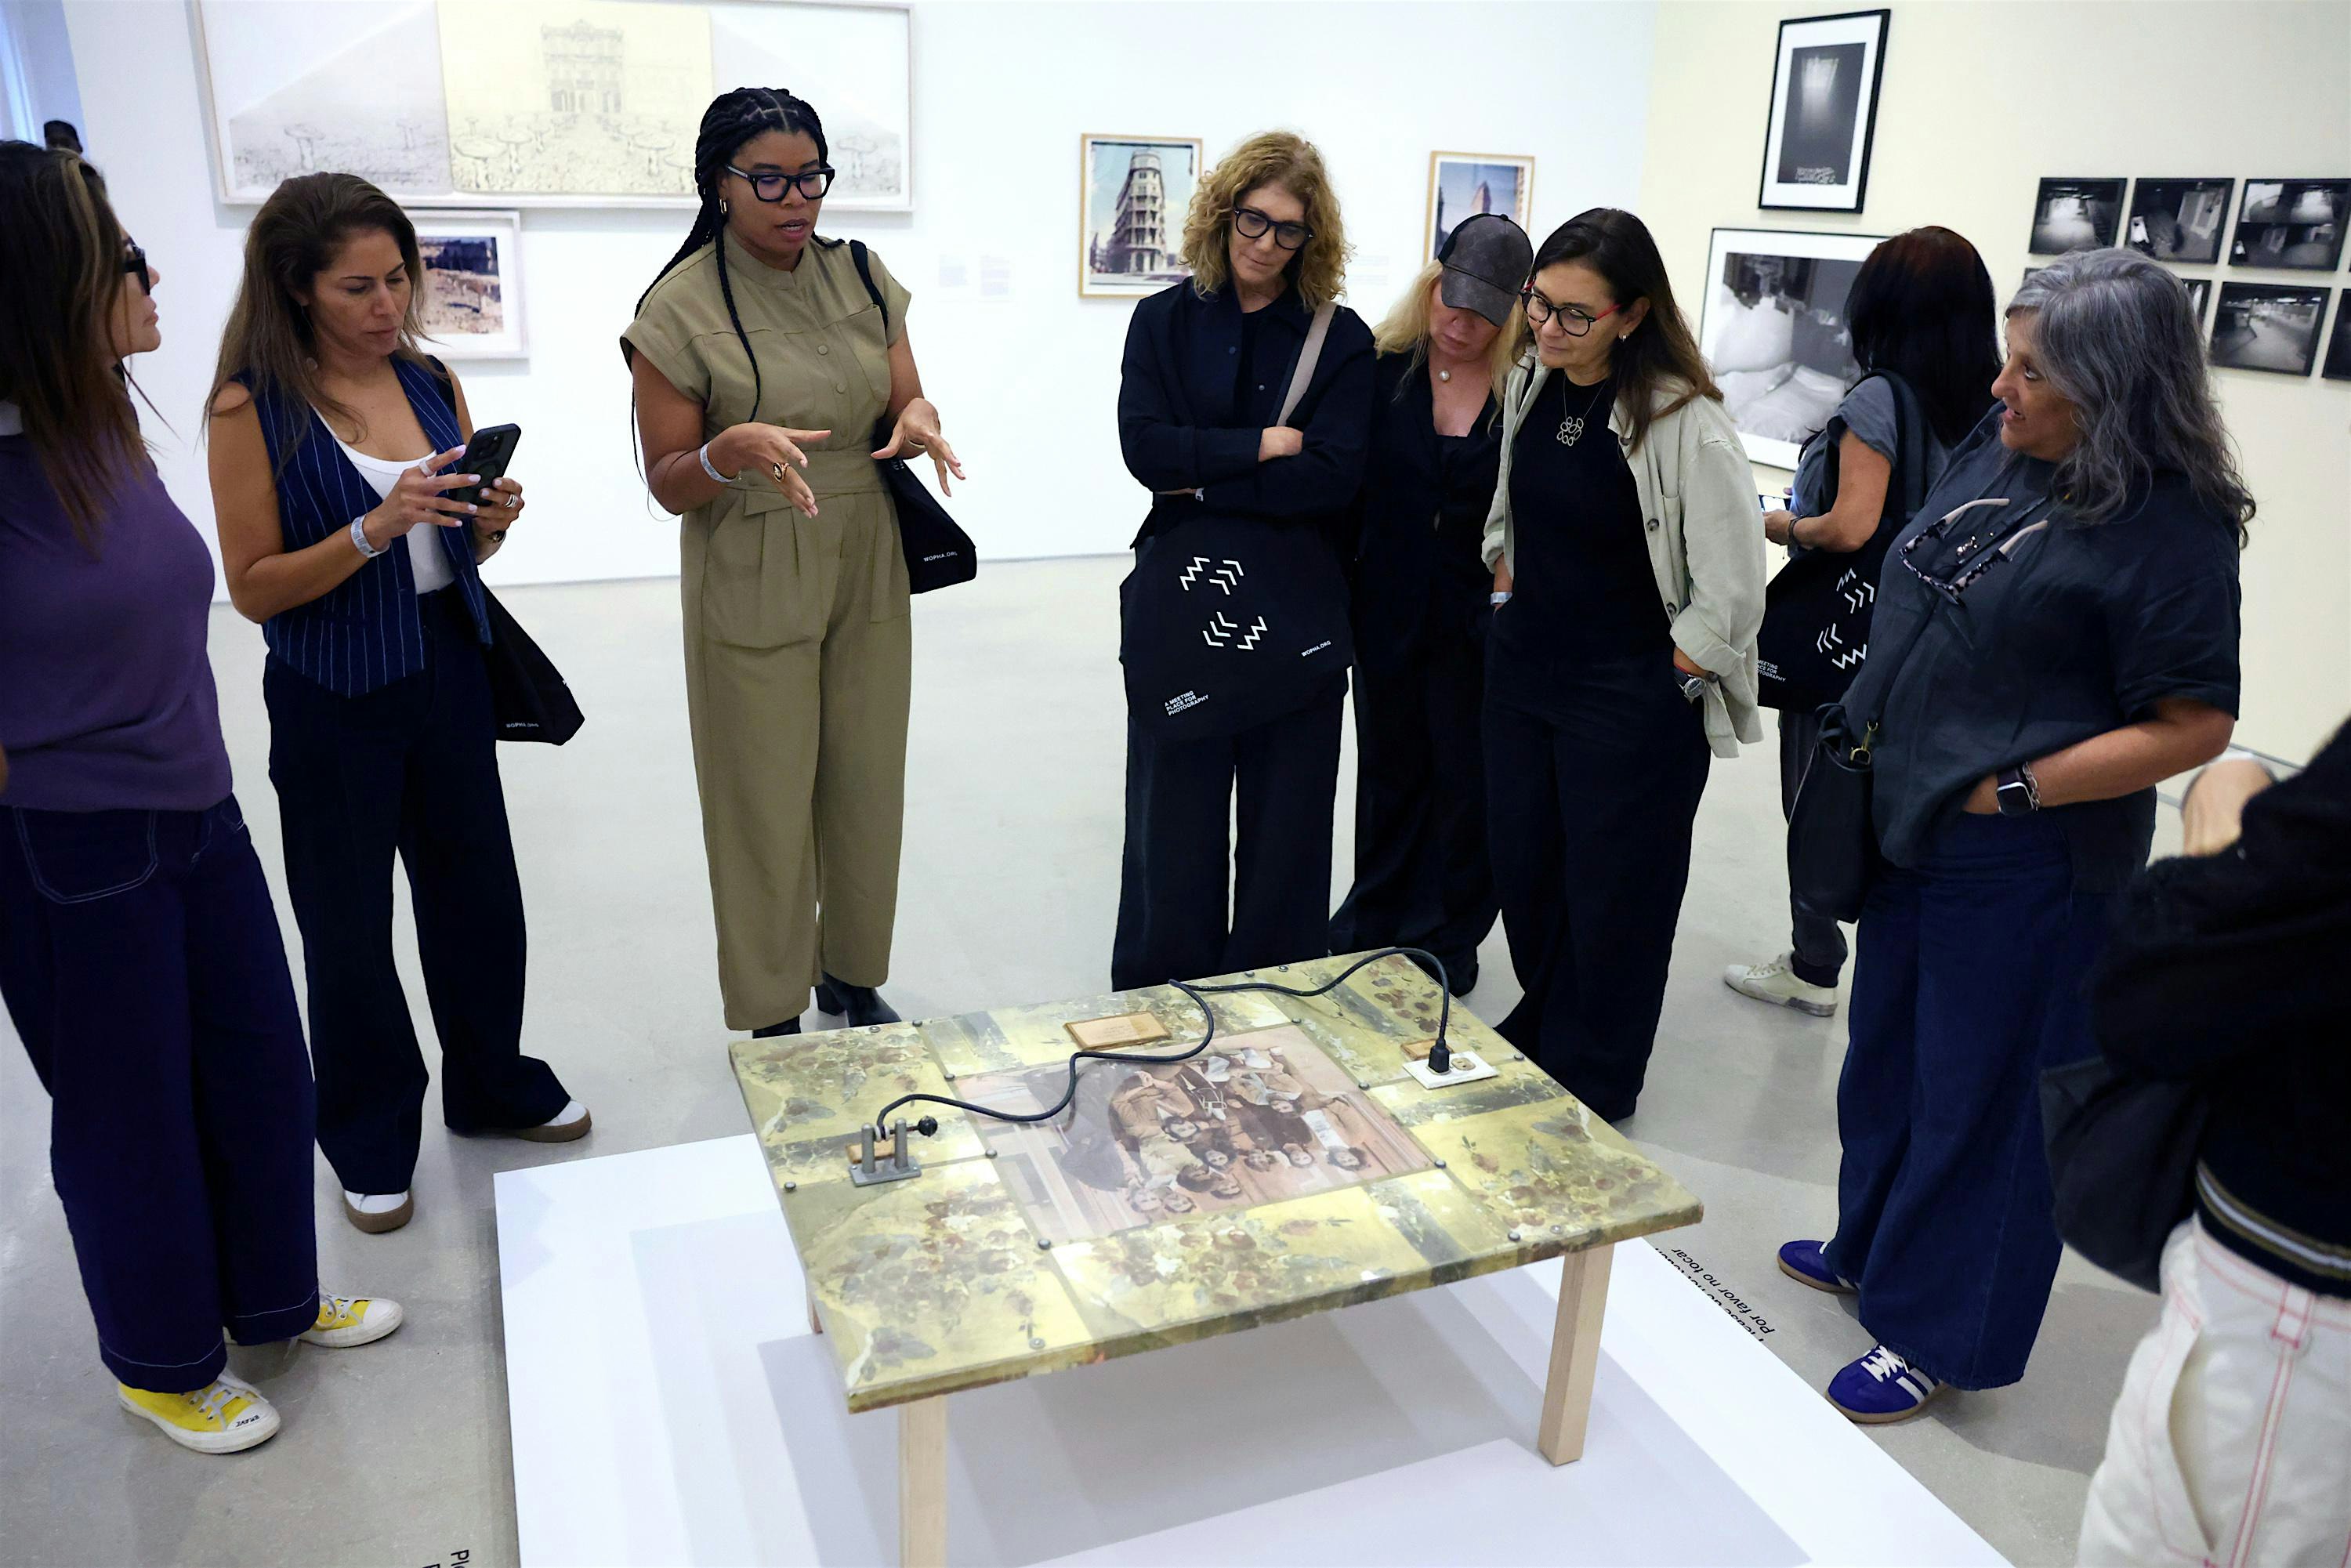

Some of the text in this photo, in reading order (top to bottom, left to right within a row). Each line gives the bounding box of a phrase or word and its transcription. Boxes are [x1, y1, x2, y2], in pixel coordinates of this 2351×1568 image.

[1301, 640, 1331, 657] WOPHA.ORG
[1757, 668, 1787, 682] OTOGRAPHY
[1166, 694, 1197, 712] PLACE FOR
[1168, 690, 1194, 704] MEETING
[1168, 694, 1208, 716] PHOTOGRAPHY
[1671, 1248, 1776, 1334] Por favor no tocar
[451, 1549, 469, 1568] Pl
